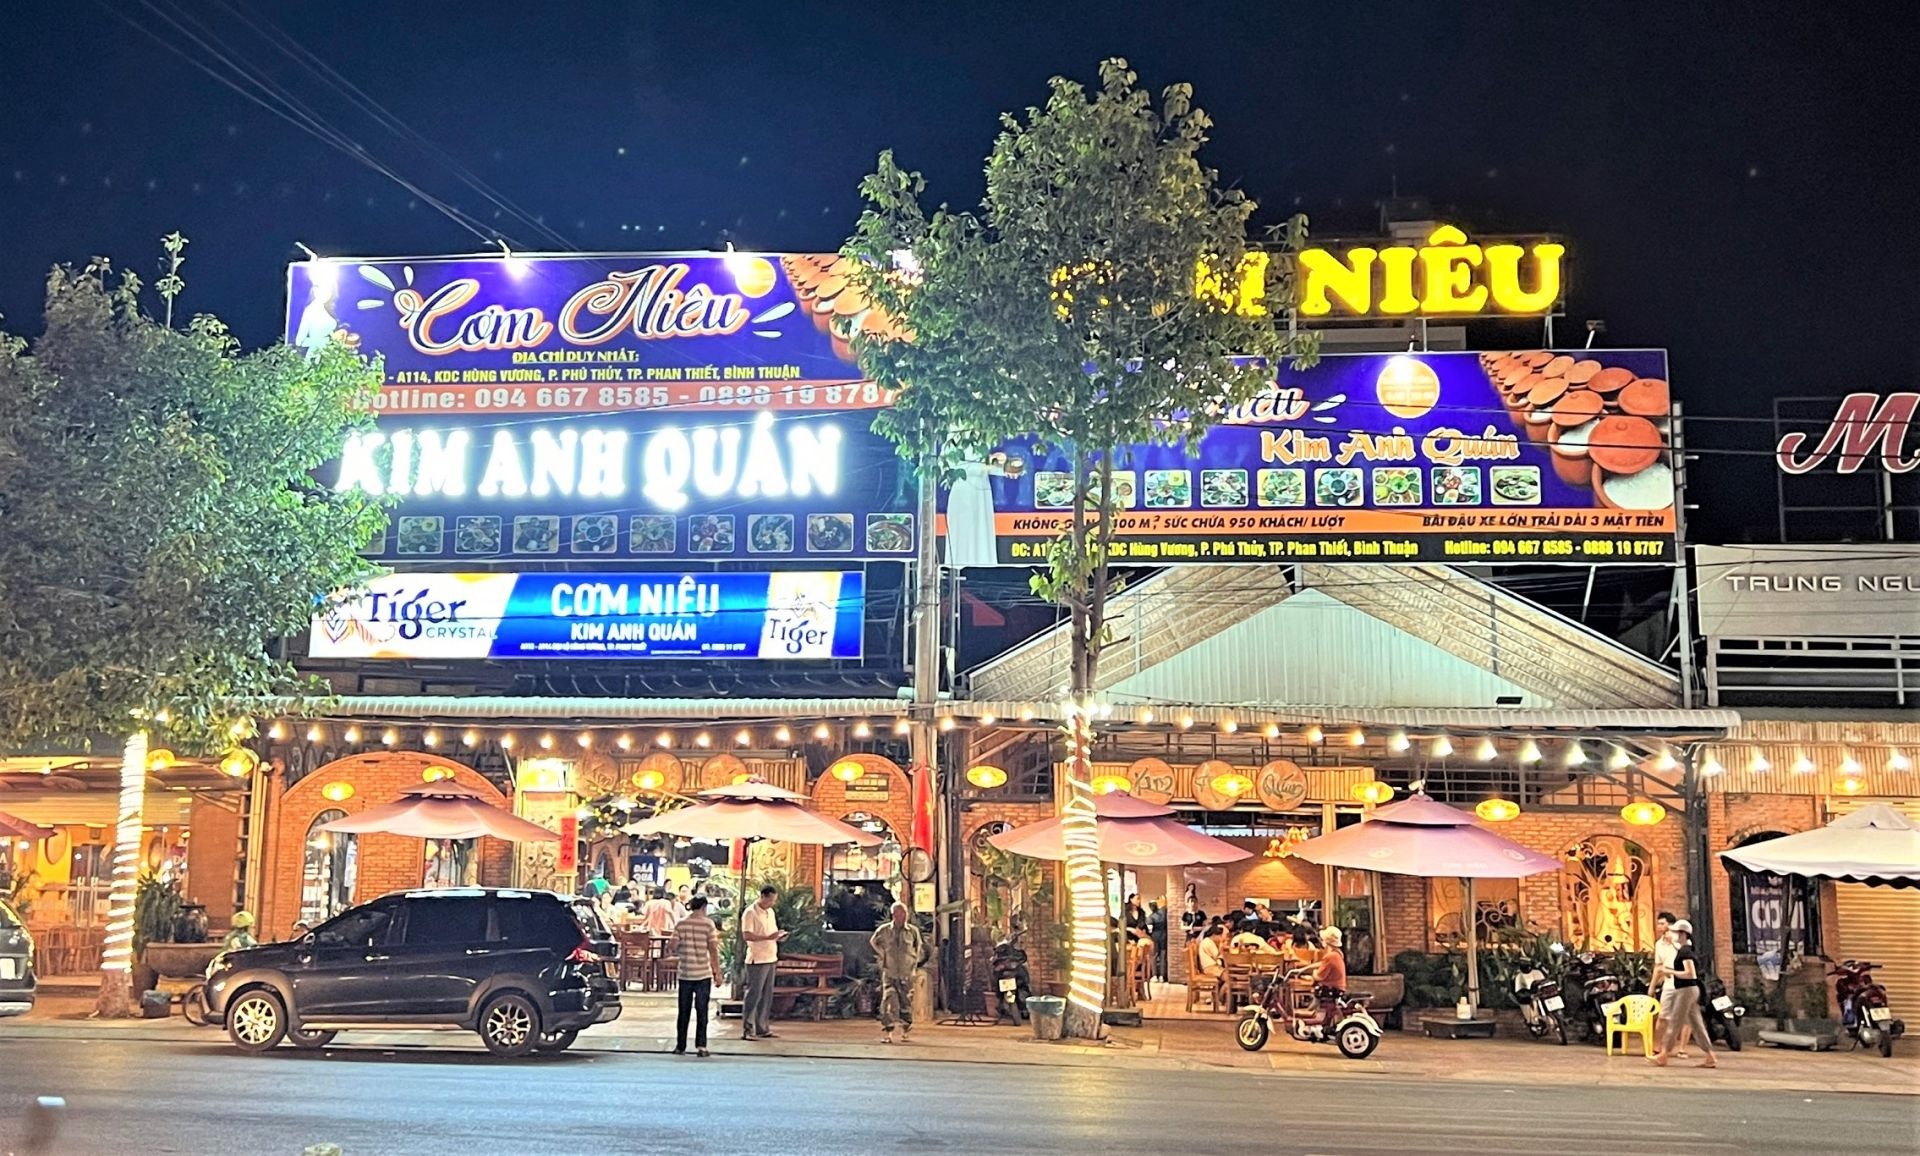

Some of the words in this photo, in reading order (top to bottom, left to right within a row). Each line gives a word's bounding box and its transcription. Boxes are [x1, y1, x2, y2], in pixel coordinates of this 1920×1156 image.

[1299, 226, 1565, 315] NIÊU
[394, 279, 552, 352] Cơm
[560, 263, 750, 343] Niêu
[566, 351, 596, 362] DUY
[397, 371, 431, 384] A114,
[435, 369, 459, 383] KDC
[463, 368, 497, 383] HÙNG
[500, 368, 545, 383] VƯƠNG,
[548, 369, 558, 381] P.
[627, 368, 643, 380] TP.
[647, 368, 681, 380] PHAN
[724, 366, 755, 380] BÌNH
[758, 365, 800, 381] THUẬN
[475, 388, 526, 407] 094
[537, 387, 588, 406] 667
[599, 386, 668, 406] 8585
[781, 385, 815, 405] 19
[1260, 429, 1332, 463] Kim
[1336, 427, 1416, 465] Anh
[1421, 425, 1520, 465] Quán
[337, 429, 466, 497] KIM
[478, 428, 627, 498] ANH
[642, 411, 842, 512] QUÁN
[1013, 516, 1059, 530] KHÔNG
[1164, 515, 1188, 529] SỨC
[1191, 515, 1225, 529] CHỨA
[1230, 517, 1255, 527] 950
[1311, 515, 1345, 530] LƯỢT
[1480, 516, 1496, 526] XE
[1499, 512, 1527, 526] LỚN
[1591, 516, 1599, 526] 3
[1129, 541, 1158, 558] Hùng
[1160, 541, 1198, 557] Vương,
[1200, 541, 1210, 556] P.
[1268, 541, 1285, 556] TP.
[1287, 541, 1316, 556] Phan
[1318, 539, 1351, 557] Thiết,
[1354, 540, 1380, 556] Bình
[1383, 540, 1418, 558] Thuận
[1444, 540, 1490, 555] Hotline:
[1492, 540, 1515, 555] 094
[1517, 540, 1540, 555] 667
[1543, 540, 1573, 555] 8585
[1616, 540, 1632, 555] 19
[1634, 540, 1664, 555] 8787
[1725, 576, 1842, 592] TRUNG
[551, 582, 629, 617] CƠM
[639, 575, 719, 617] NIÊU
[365, 588, 467, 640] Tiger
[426, 626, 498, 640] CRYSTAL
[571, 623, 603, 641] KIM
[608, 623, 645, 641] ANH
[648, 620, 697, 641] QUÁN
[770, 617, 829, 654] Tiger
